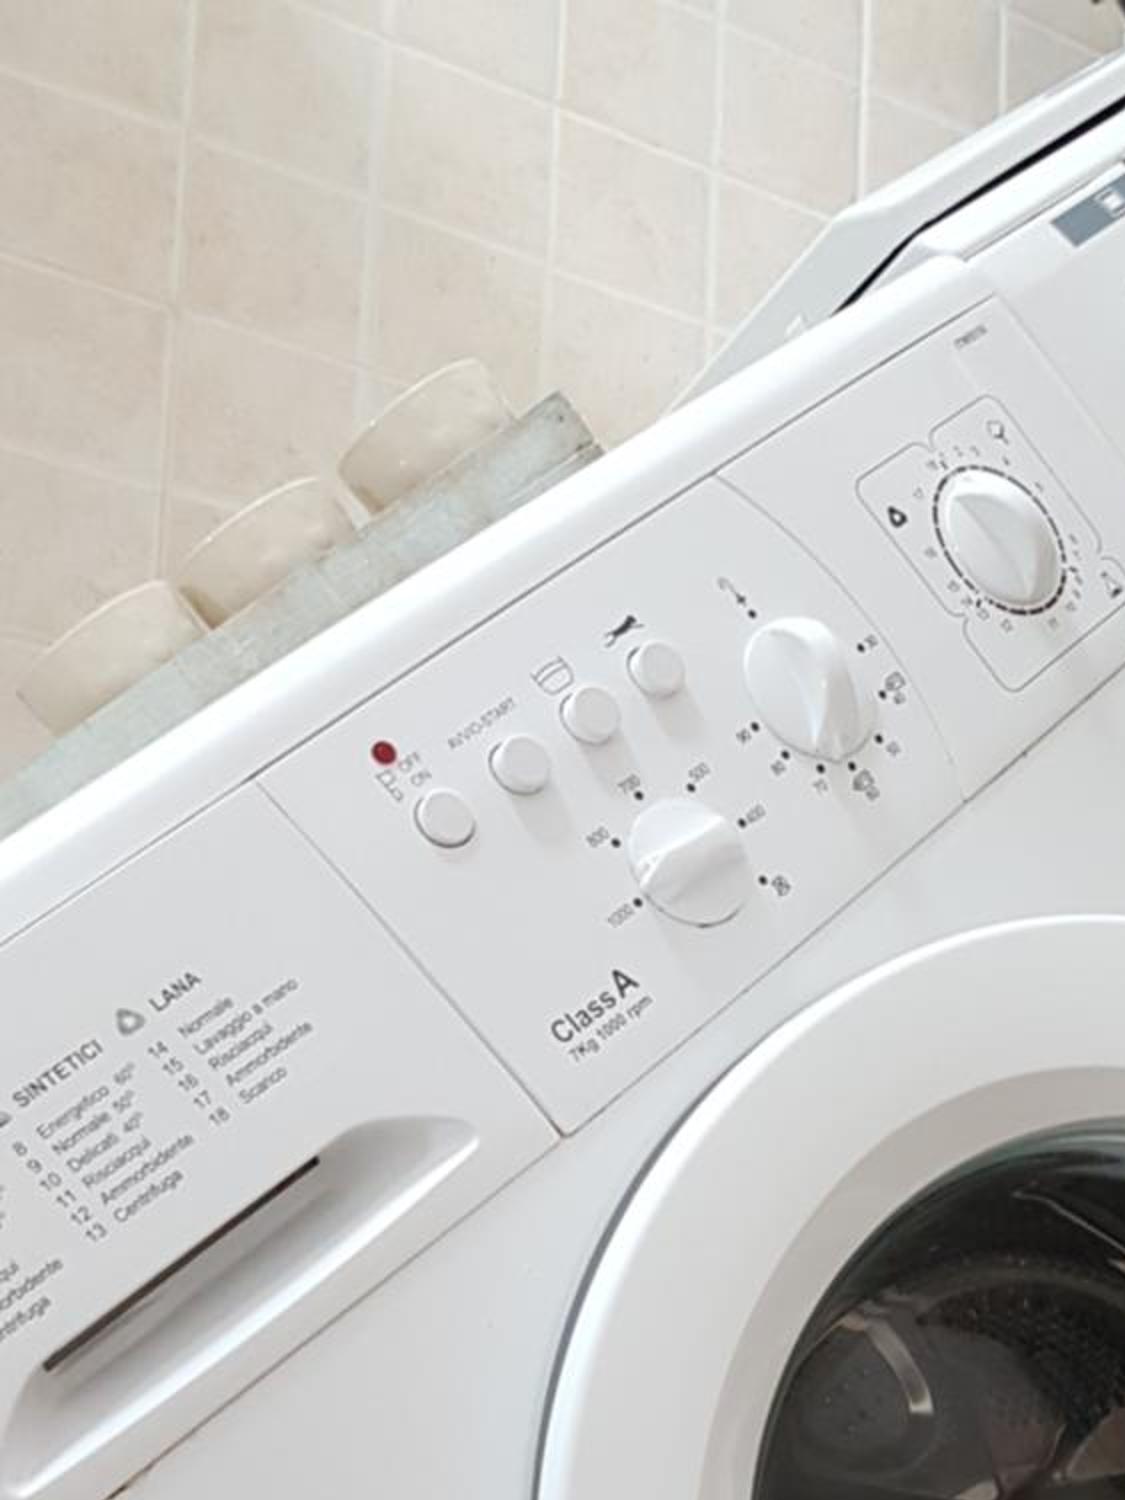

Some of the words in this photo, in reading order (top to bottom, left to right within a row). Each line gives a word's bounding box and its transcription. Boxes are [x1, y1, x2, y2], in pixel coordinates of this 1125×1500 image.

[147, 1040, 169, 1058] 14
[176, 996, 234, 1038] Normale
[148, 972, 202, 1012] LANA
[162, 1057, 184, 1076] 15
[192, 1010, 254, 1055] Lavaggio
[261, 978, 300, 1008] mano
[12, 1038, 104, 1108] SINTETICI
[193, 1089, 212, 1109] 17
[225, 1021, 314, 1087] Ammorbidente
[207, 1019, 274, 1073] Risciacqui
[239, 1066, 288, 1105] Scarico
[12, 1140, 28, 1157] 8
[36, 1085, 110, 1139] Energetico
[26, 1158, 43, 1175] 9
[51, 1111, 112, 1155] Normale
[40, 1171, 62, 1192] 10
[66, 1132, 120, 1173] Delicati
[56, 1189, 77, 1208] 11
[81, 1135, 152, 1188] Risciacqui
[70, 1205, 92, 1225] 12
[101, 1135, 195, 1206] Ammorbidente
[85, 1222, 107, 1242] 13
[113, 1169, 184, 1223] Centrifuga
